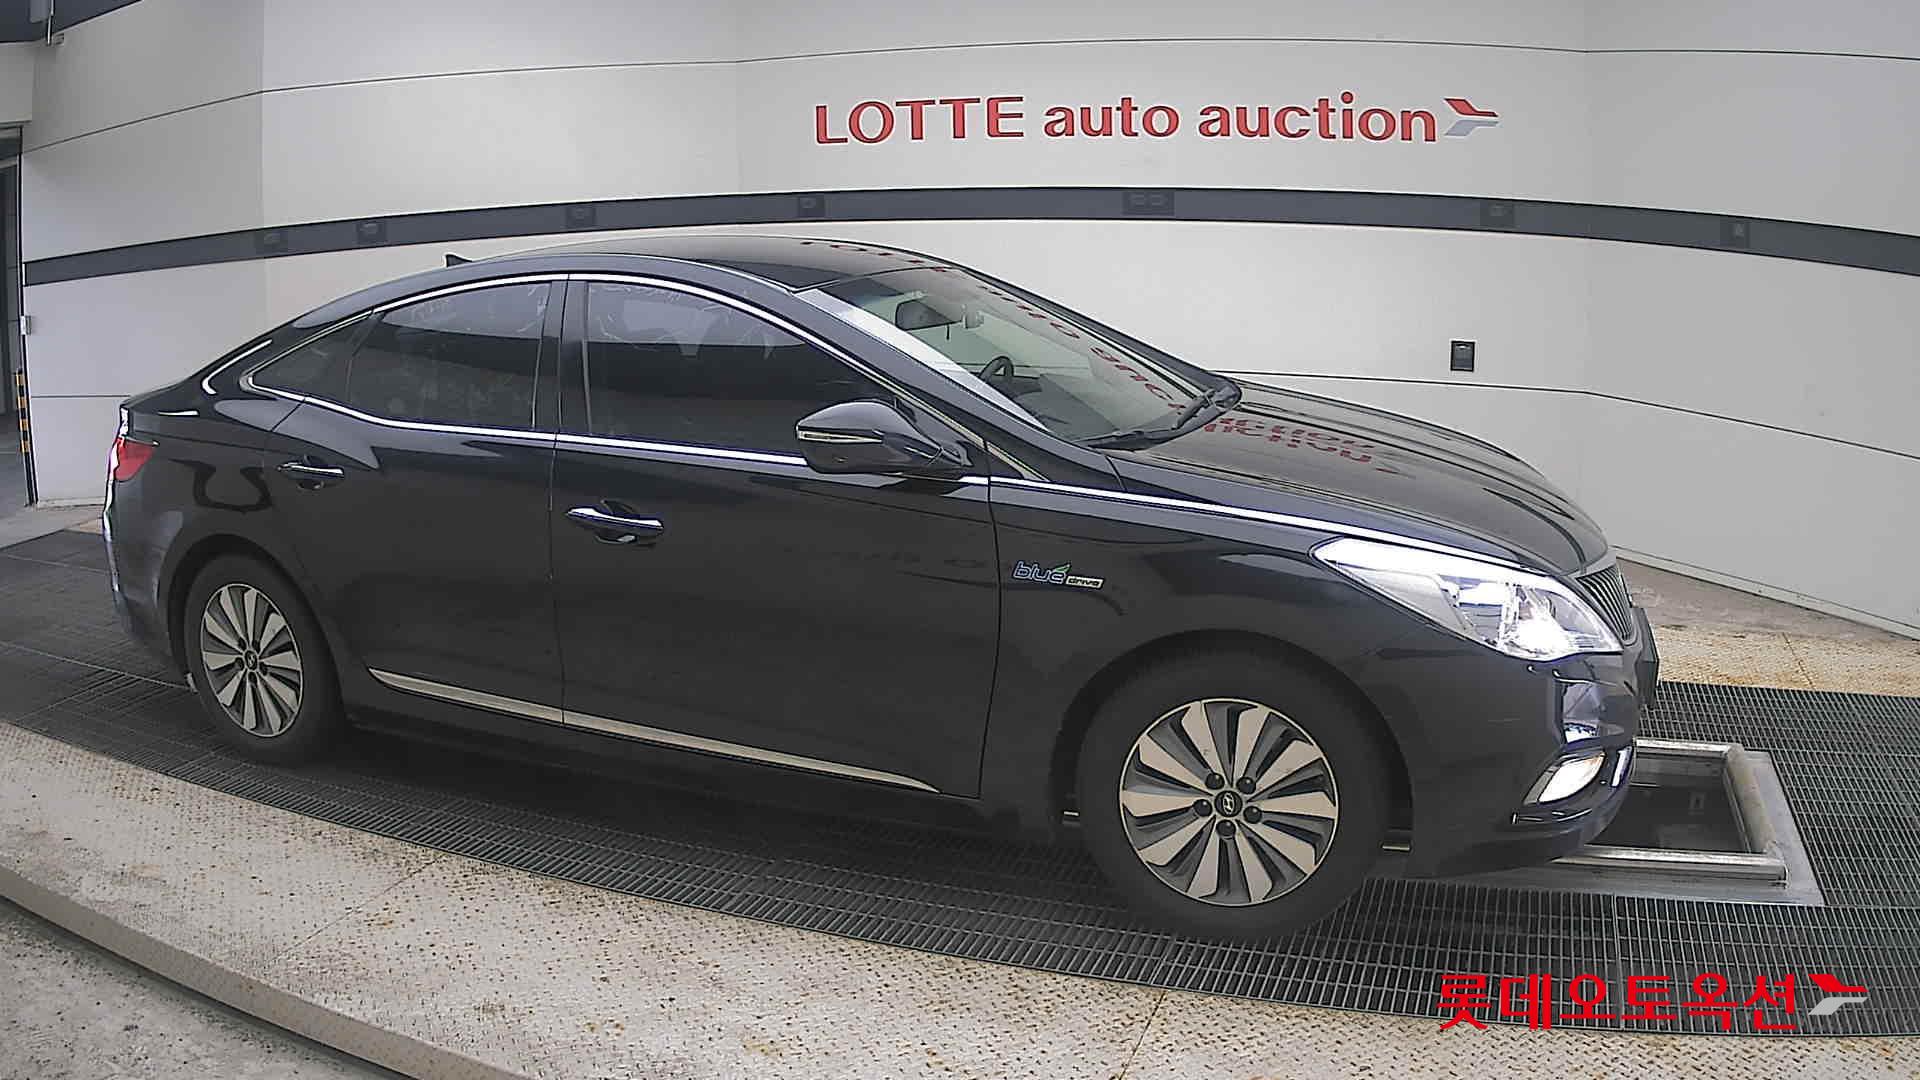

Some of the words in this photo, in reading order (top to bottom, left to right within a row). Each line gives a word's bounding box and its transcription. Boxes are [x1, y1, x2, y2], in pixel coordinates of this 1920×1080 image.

[815, 96, 1025, 144] LOTTE
[1043, 97, 1180, 138] auto
[1198, 91, 1437, 143] auction
[1013, 560, 1066, 584] blue
